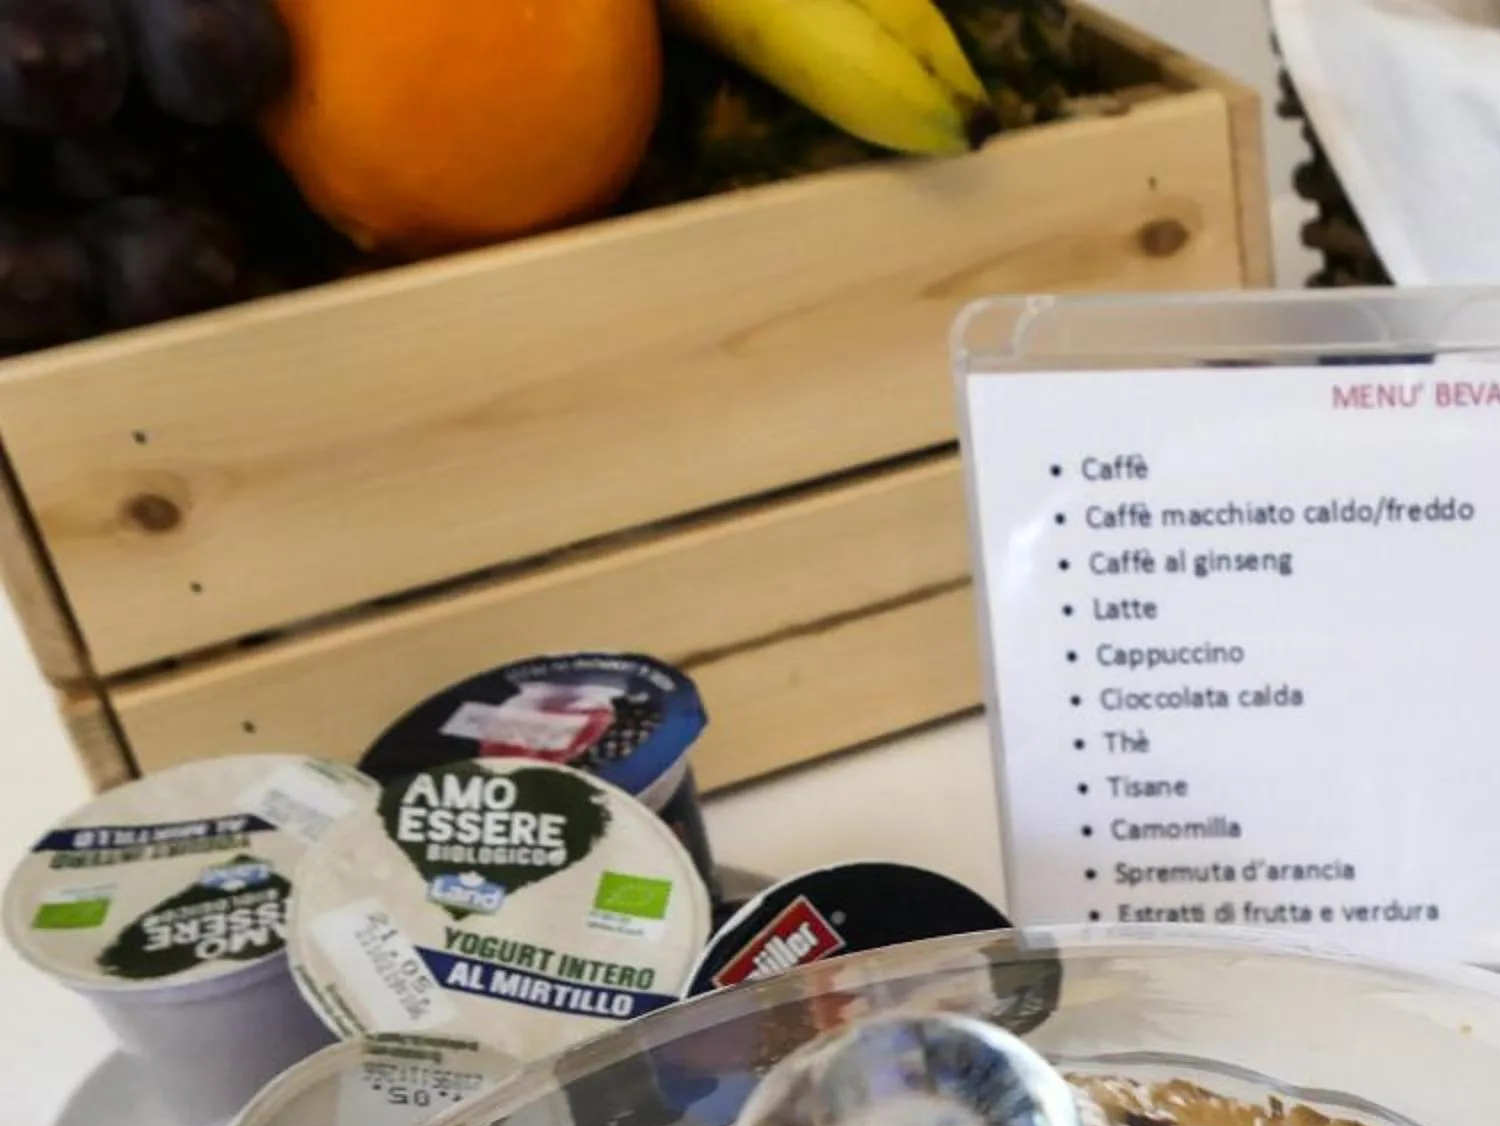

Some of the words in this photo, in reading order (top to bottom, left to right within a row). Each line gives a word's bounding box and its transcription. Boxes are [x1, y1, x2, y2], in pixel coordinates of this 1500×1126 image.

[1081, 453, 1148, 481] Caffè
[1085, 502, 1152, 529] Caffè
[1161, 501, 1295, 527] macchiato
[1303, 496, 1475, 527] caldo/freddo
[1089, 548, 1156, 575] Caffè
[1164, 550, 1187, 573] al
[1194, 551, 1293, 578] ginseng
[1093, 598, 1158, 620] Latte
[1096, 641, 1245, 669] Cappuccino
[1100, 685, 1229, 710] Cioccolata
[1238, 684, 1304, 707] calda
[1104, 729, 1150, 753] Thè
[402, 772, 518, 811] AMO
[1107, 775, 1188, 798] Tisane
[398, 806, 567, 848] ESSERE
[1110, 817, 1242, 841] Camomilla
[425, 843, 548, 866] BIOLOGICO
[1115, 861, 1236, 887] Spremuta
[1118, 903, 1205, 923] Estratti
[1214, 902, 1236, 923] di
[1243, 900, 1312, 923] frutta
[1319, 906, 1334, 923] e
[1342, 900, 1440, 922] verdura
[143, 902, 287, 952] SSERE
[444, 926, 554, 971] YOGURT
[557, 953, 656, 990] INTERO
[446, 961, 486, 990] AL
[490, 970, 635, 1018] MIRTILLO
